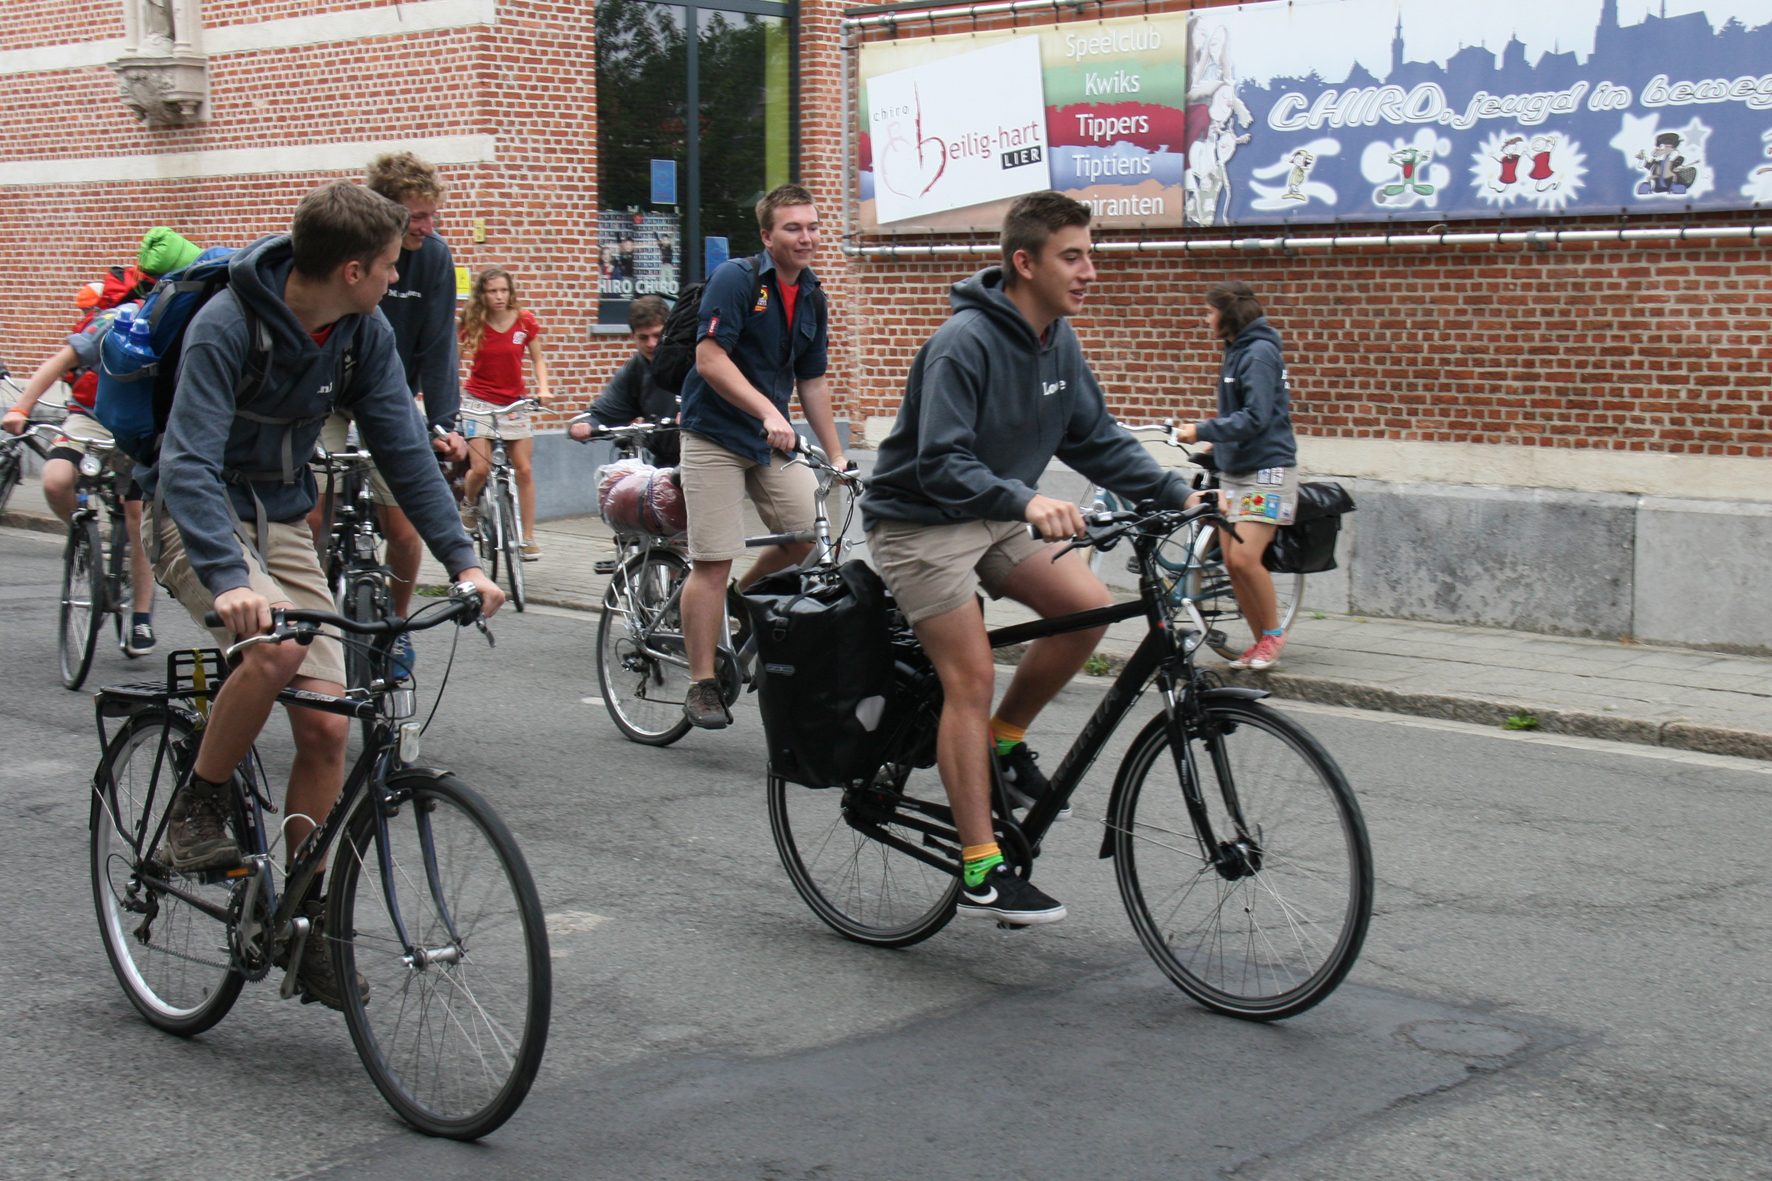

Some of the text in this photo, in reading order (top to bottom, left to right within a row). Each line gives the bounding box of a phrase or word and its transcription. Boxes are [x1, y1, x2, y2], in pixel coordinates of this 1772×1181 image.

[1065, 26, 1161, 62] Speelclub
[1085, 69, 1141, 95] Kwiks
[873, 104, 910, 122] chiro
[1269, 82, 1454, 131] CHIRO,
[1451, 80, 1589, 130] jeugd
[1588, 81, 1632, 112] in
[1075, 113, 1149, 142] Tippers
[1003, 148, 1041, 168] LIER
[1072, 153, 1152, 182] Tiptiens
[1075, 194, 1164, 217] iranten
[635, 280, 679, 295] CHIRO
